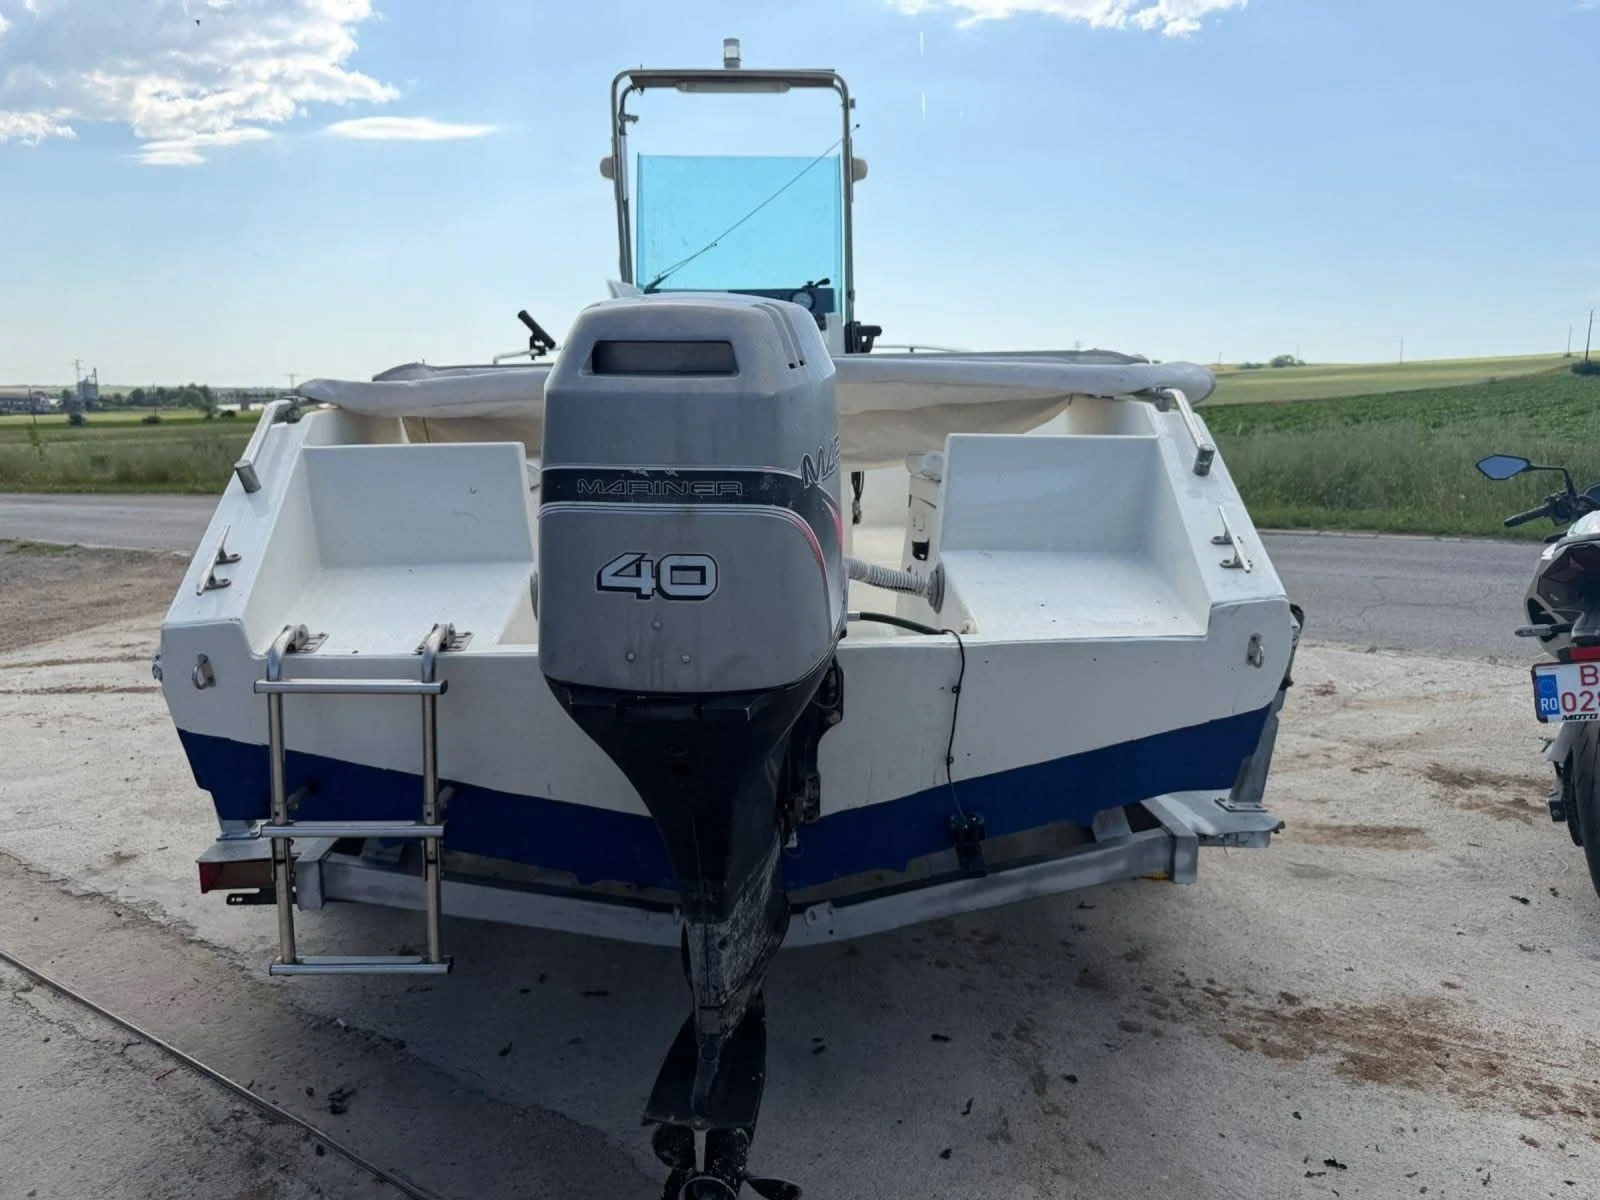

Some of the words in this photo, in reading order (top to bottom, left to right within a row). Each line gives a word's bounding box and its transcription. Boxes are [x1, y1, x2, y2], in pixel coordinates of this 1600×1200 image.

[577, 478, 744, 496] MARINER
[596, 551, 719, 601] 40
[1580, 664, 1599, 686] B
[1540, 697, 1558, 711] RO
[1561, 690, 1600, 713] 02
[1561, 713, 1599, 721] MOTO
